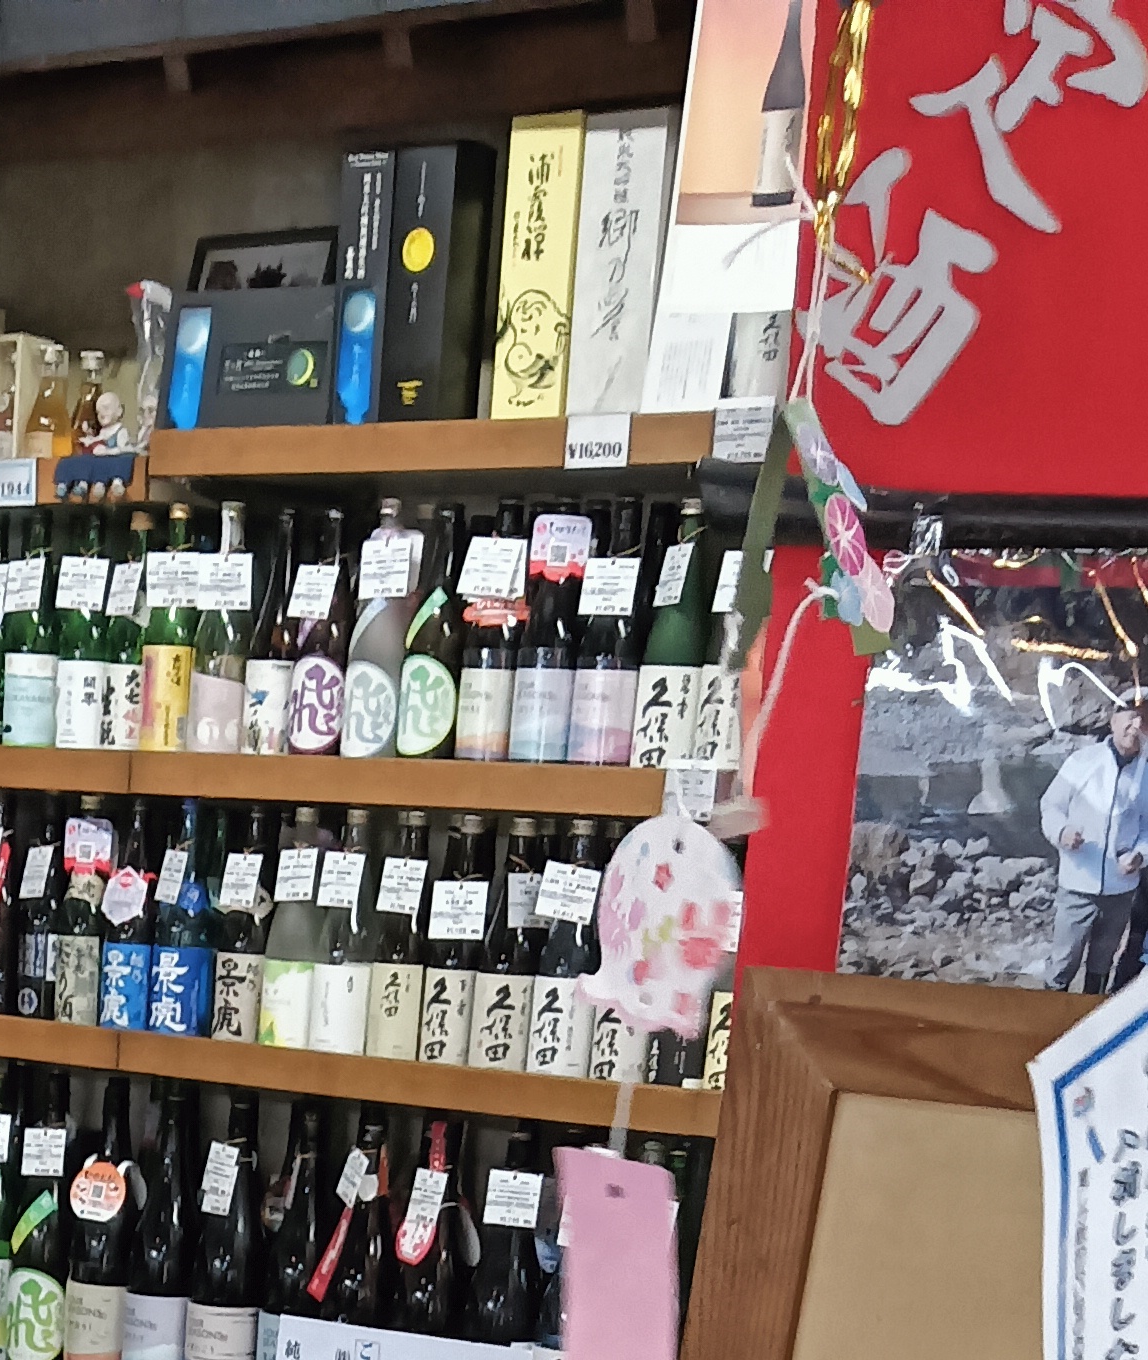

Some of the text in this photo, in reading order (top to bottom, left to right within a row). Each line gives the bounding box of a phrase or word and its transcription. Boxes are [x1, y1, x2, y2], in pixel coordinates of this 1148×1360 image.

[636, 677, 673, 768] 久保田
[100, 949, 131, 1027] 景虎
[149, 950, 189, 1032] 景虎
[212, 957, 246, 1037] 景虎
[424, 976, 450, 1061] 久保田
[480, 983, 516, 1063] 久保田
[533, 987, 563, 1067] 久保田
